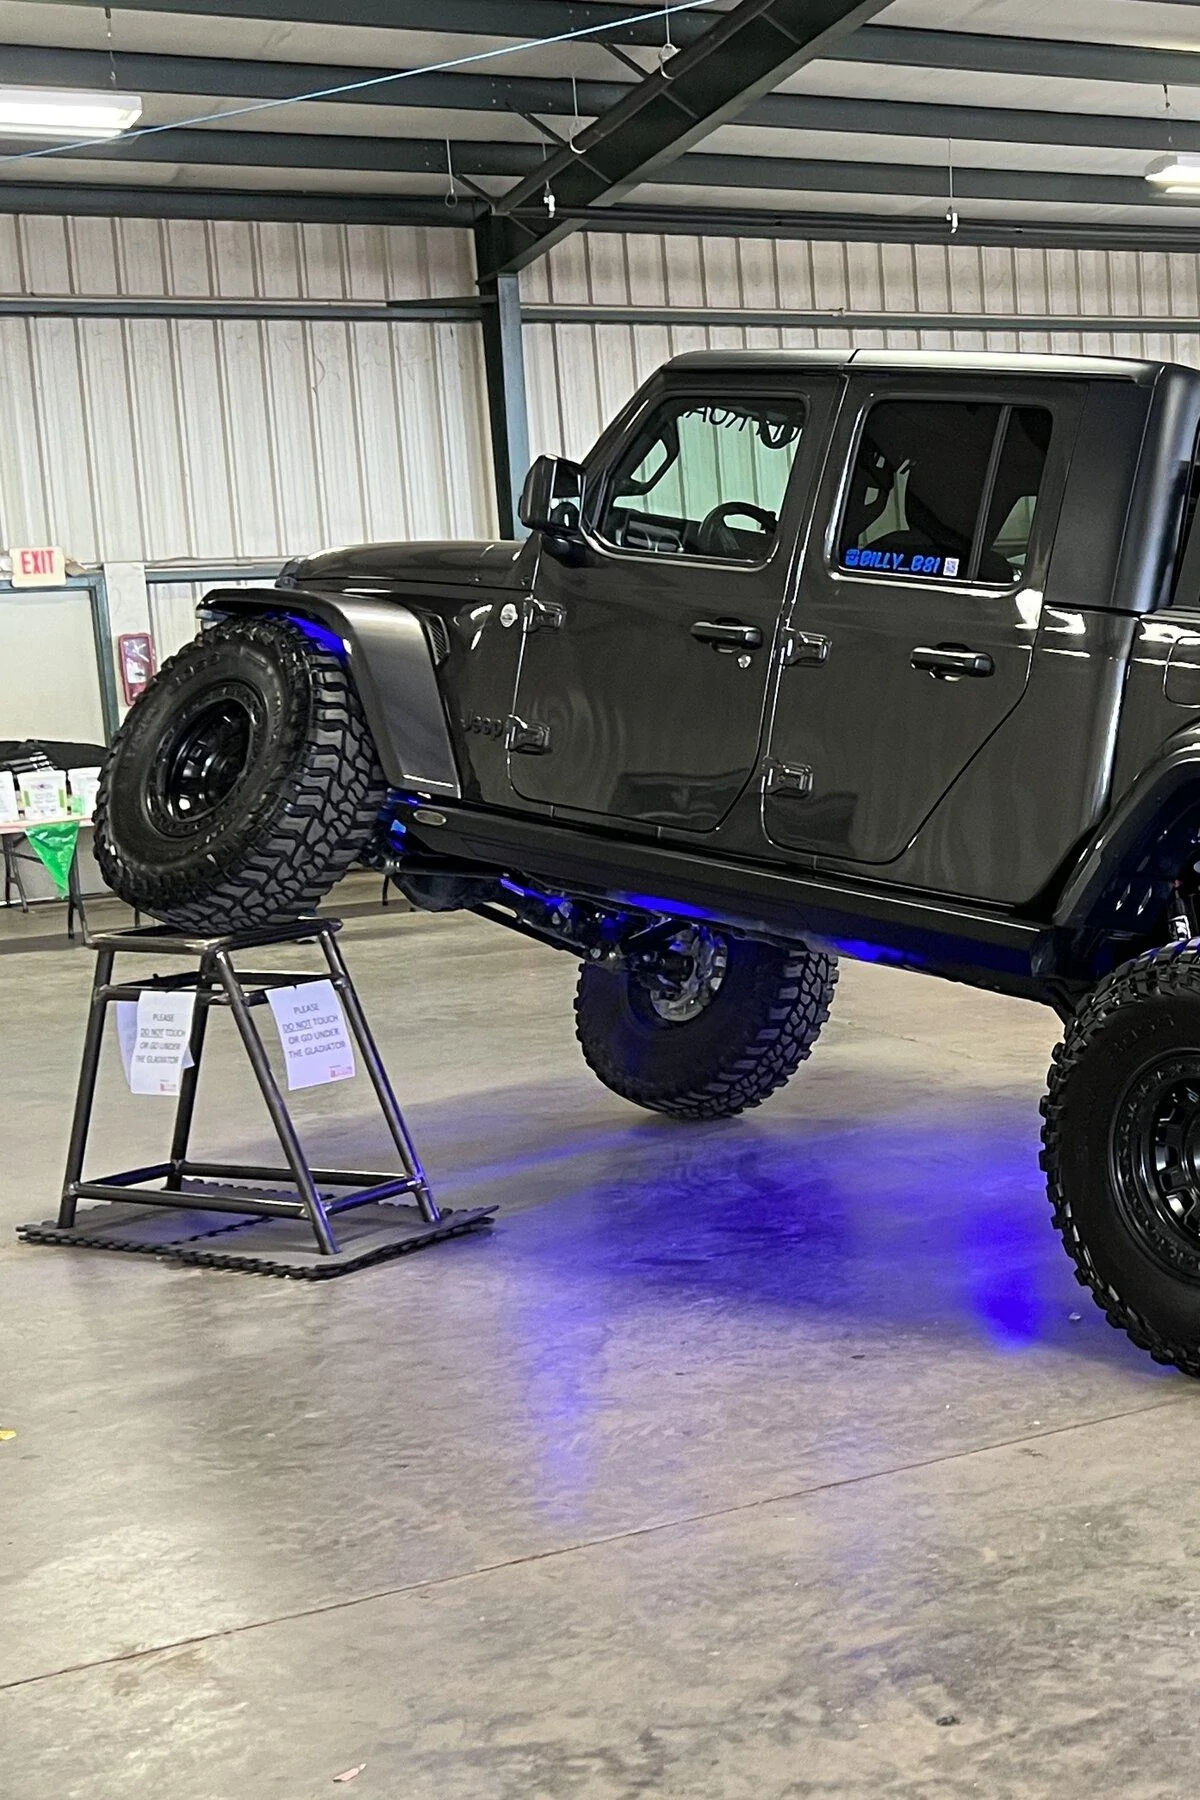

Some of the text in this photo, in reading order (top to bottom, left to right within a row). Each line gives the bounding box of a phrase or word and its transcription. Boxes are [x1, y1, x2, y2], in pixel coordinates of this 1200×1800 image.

[20, 550, 54, 575] EXIT
[293, 1003, 319, 1015] PLEASE
[152, 1013, 175, 1022] PLEASE
[282, 1014, 338, 1033] DO NOT TOUCH
[140, 1028, 186, 1038] DO NOT TOUCH
[288, 1028, 339, 1045] OR GO UNDER
[288, 1040, 346, 1058] THE GLADIATOR
[135, 1055, 180, 1065] THE GLADIATOR
